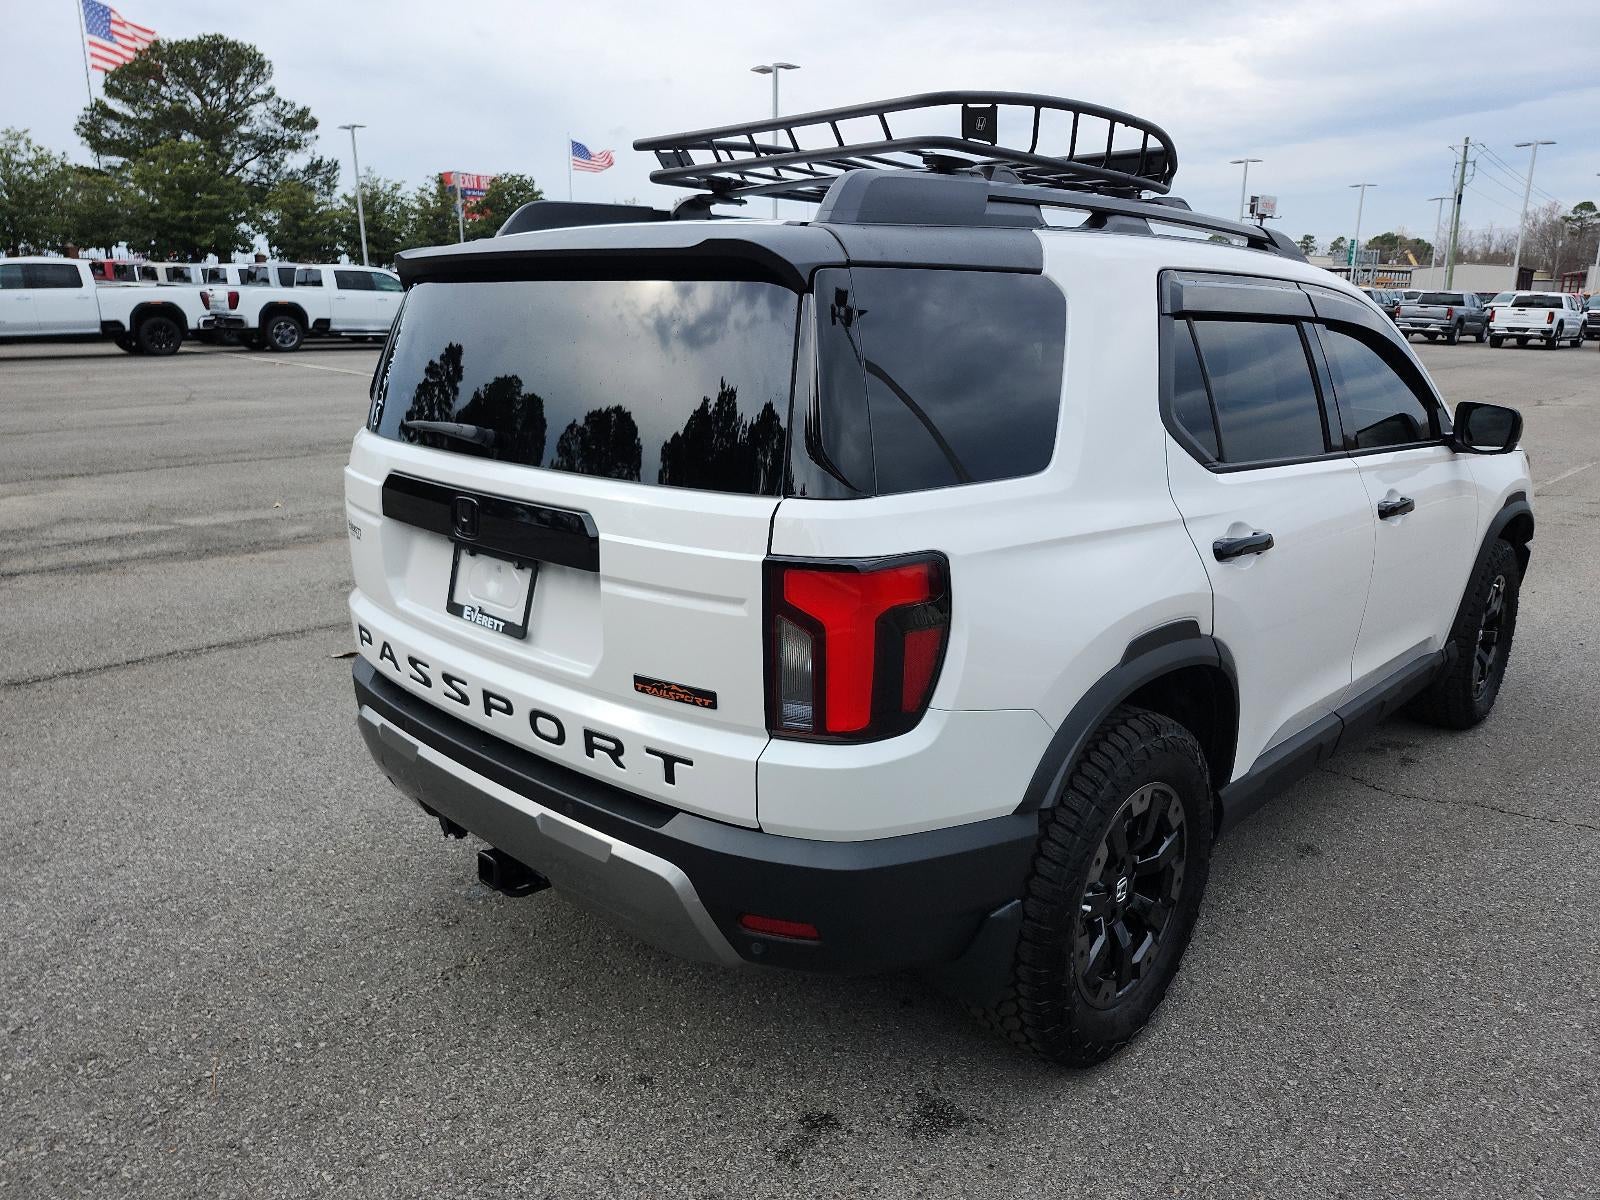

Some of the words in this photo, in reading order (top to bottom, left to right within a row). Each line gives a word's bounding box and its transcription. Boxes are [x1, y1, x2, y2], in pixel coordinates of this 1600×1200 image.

[463, 605, 505, 633] EVERETT
[357, 623, 694, 786] PASSPORT
[635, 683, 713, 707] TRAILSPORT
